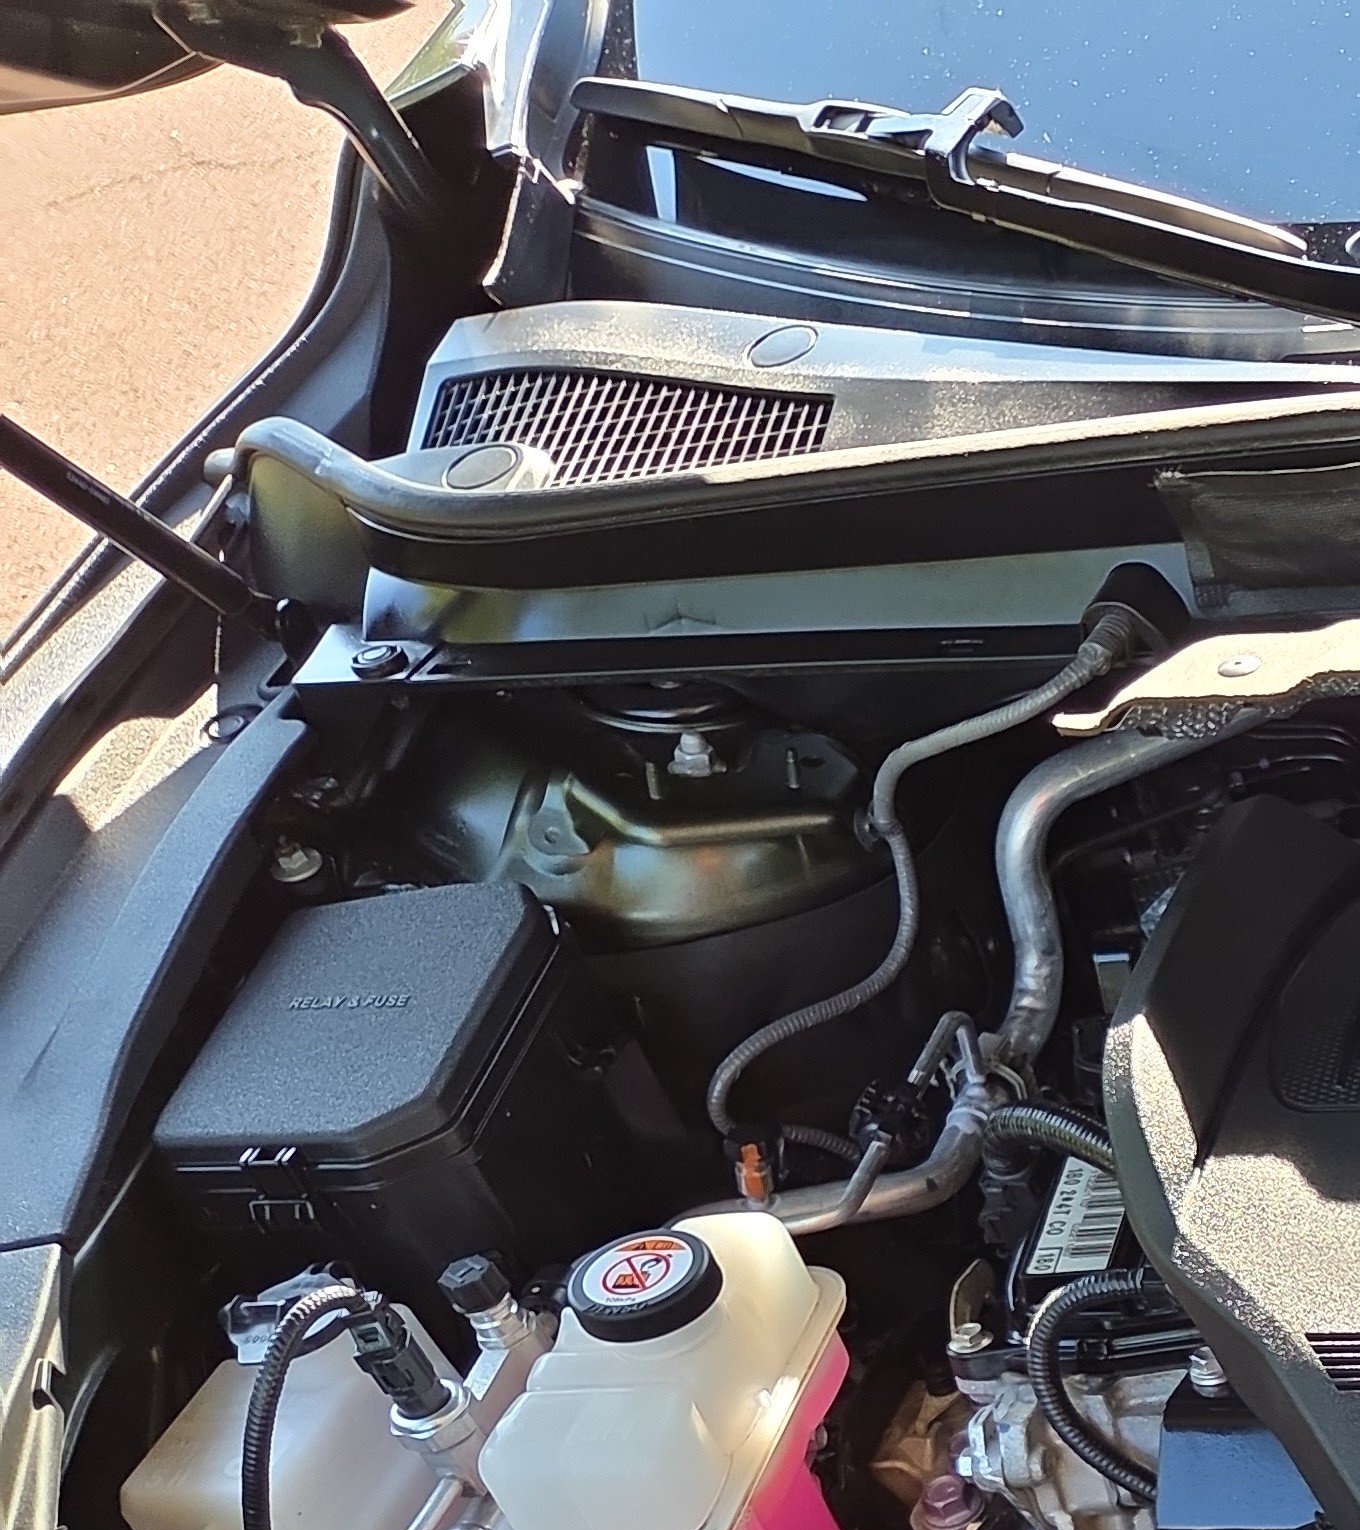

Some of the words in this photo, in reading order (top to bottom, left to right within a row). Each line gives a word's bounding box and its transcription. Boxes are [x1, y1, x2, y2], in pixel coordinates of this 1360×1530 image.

[288, 996, 346, 1010] RELAY
[348, 995, 360, 1009] &
[362, 993, 411, 1008] FUSE
